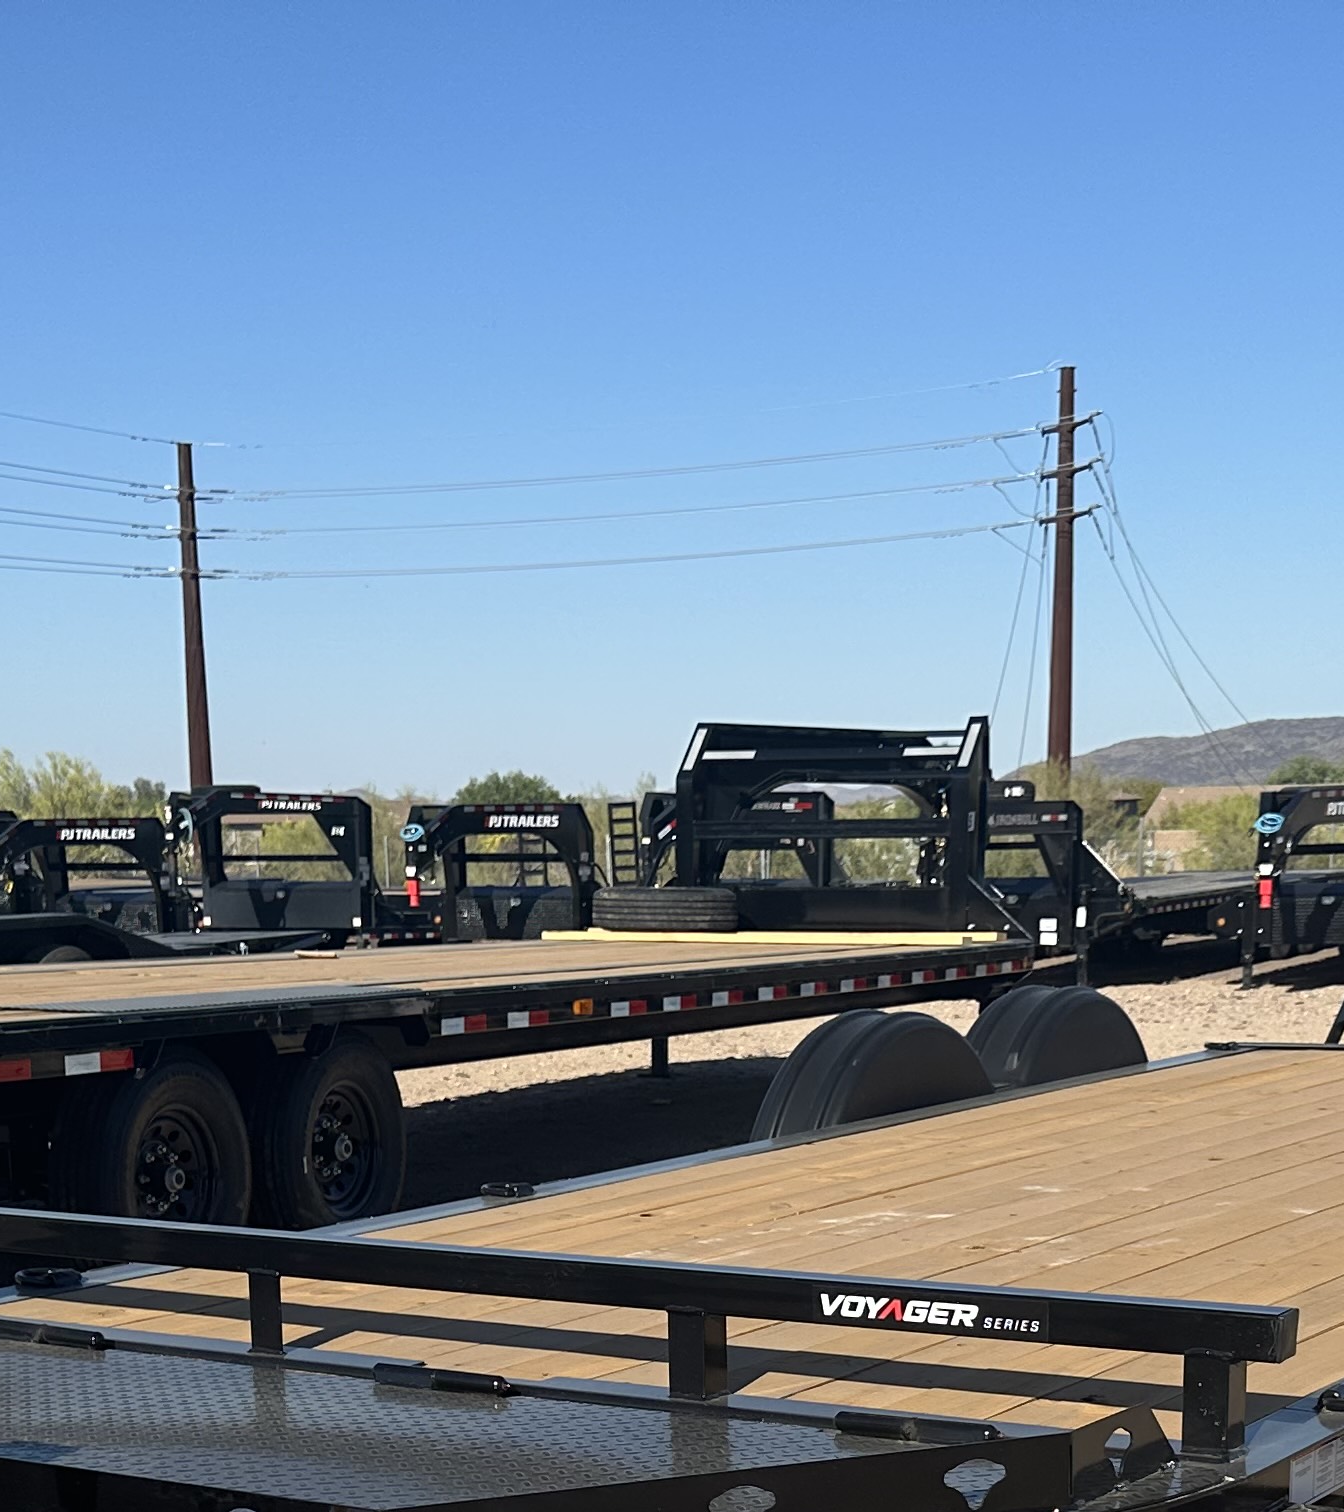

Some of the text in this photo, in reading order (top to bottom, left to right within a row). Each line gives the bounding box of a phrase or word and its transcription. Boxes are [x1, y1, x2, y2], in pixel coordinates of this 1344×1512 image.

[261, 800, 322, 811] PJ TRAILERS
[489, 815, 559, 827] PJ TRAILERS
[60, 828, 136, 840] PJ TRAILERS
[820, 1293, 1041, 1333] VOYAGER SERIES
